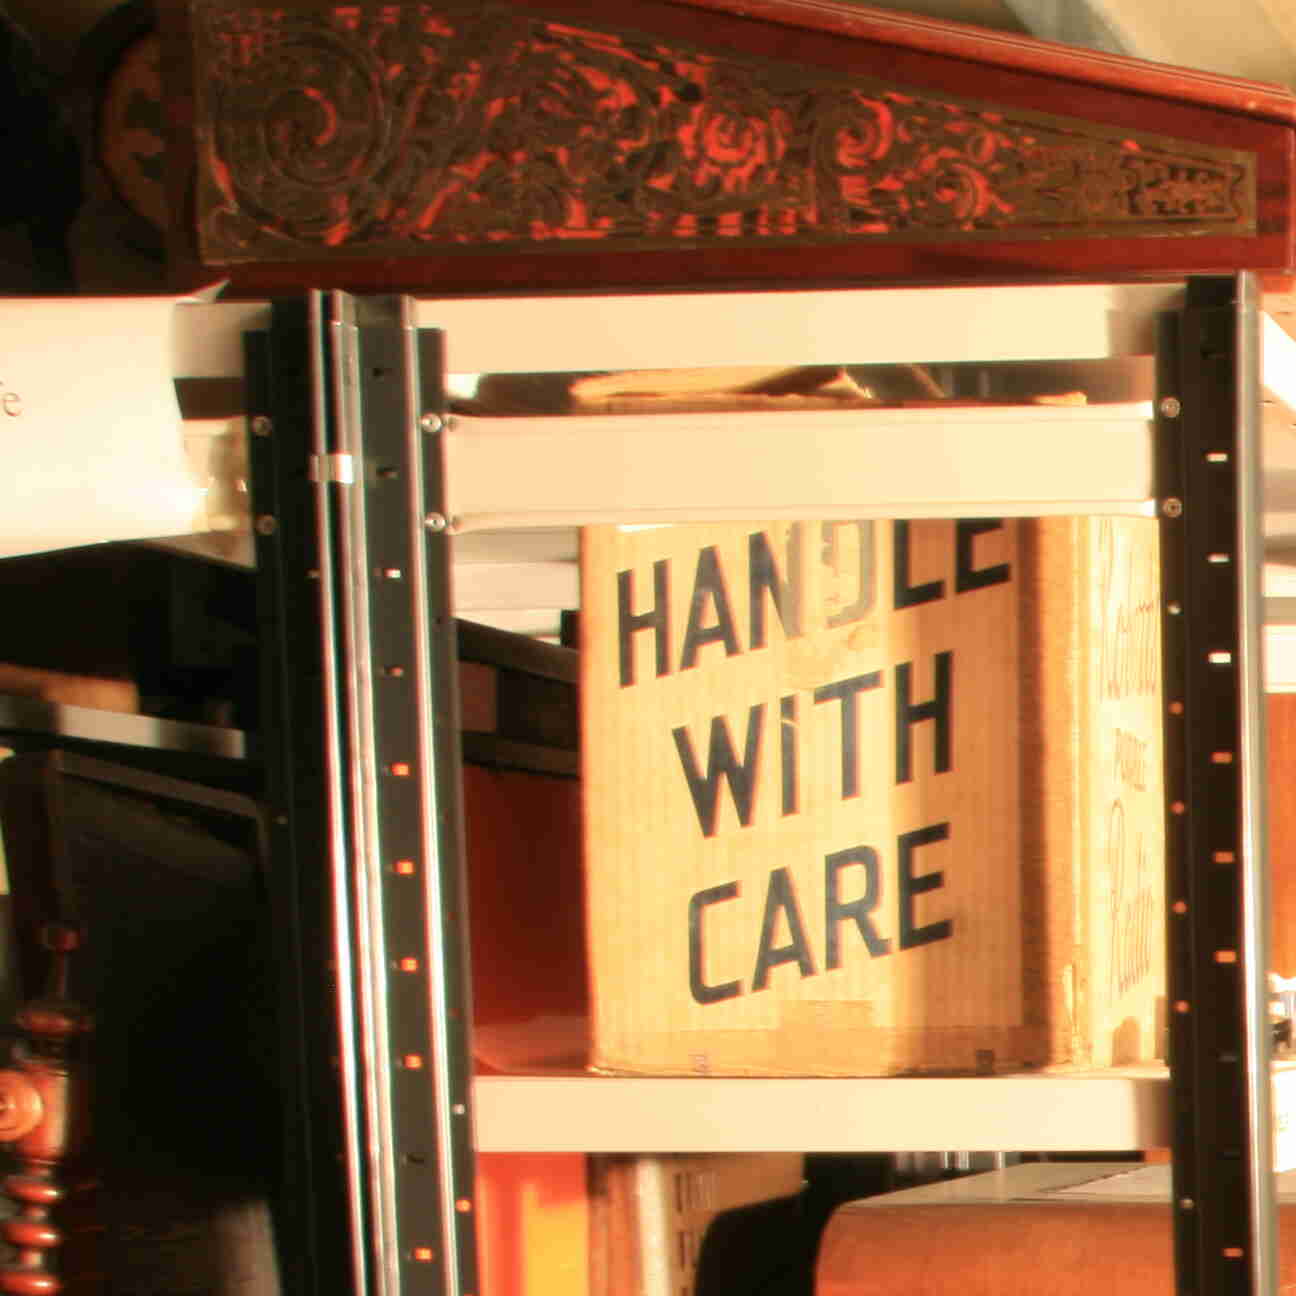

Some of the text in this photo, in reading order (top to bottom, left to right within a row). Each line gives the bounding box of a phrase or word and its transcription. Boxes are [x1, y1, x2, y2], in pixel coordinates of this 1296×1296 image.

[616, 517, 1013, 689] HANDLE
[672, 651, 955, 839] WITH
[687, 822, 954, 1006] CARE
